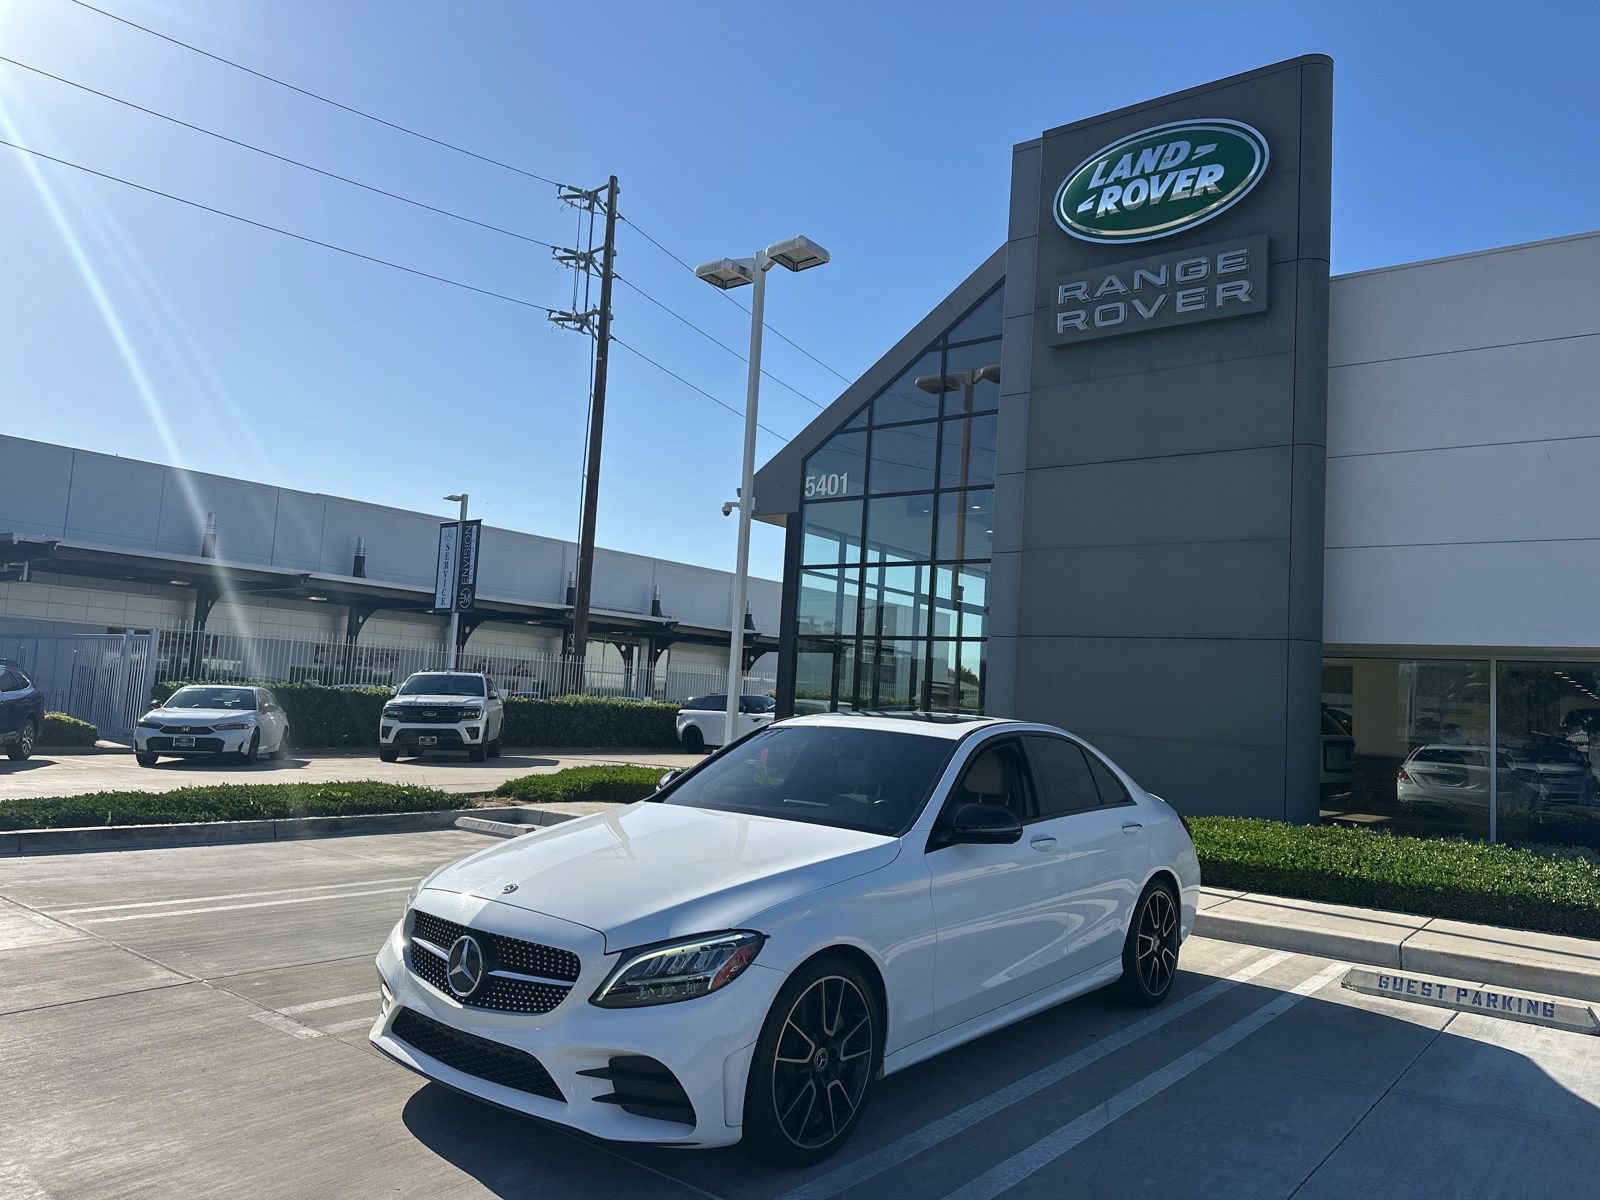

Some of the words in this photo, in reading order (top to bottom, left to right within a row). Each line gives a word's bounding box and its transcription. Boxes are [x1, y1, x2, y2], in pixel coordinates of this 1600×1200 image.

[1087, 140, 1191, 190] LAND
[1095, 164, 1225, 219] ROVER
[1057, 248, 1250, 305] RANGE
[1057, 279, 1254, 334] ROVER
[804, 472, 848, 497] 5401
[440, 543, 451, 606] SERVICE
[461, 525, 473, 585] ENVISION
[1378, 975, 1447, 999] GUEST
[1456, 988, 1556, 1019] PARKING
